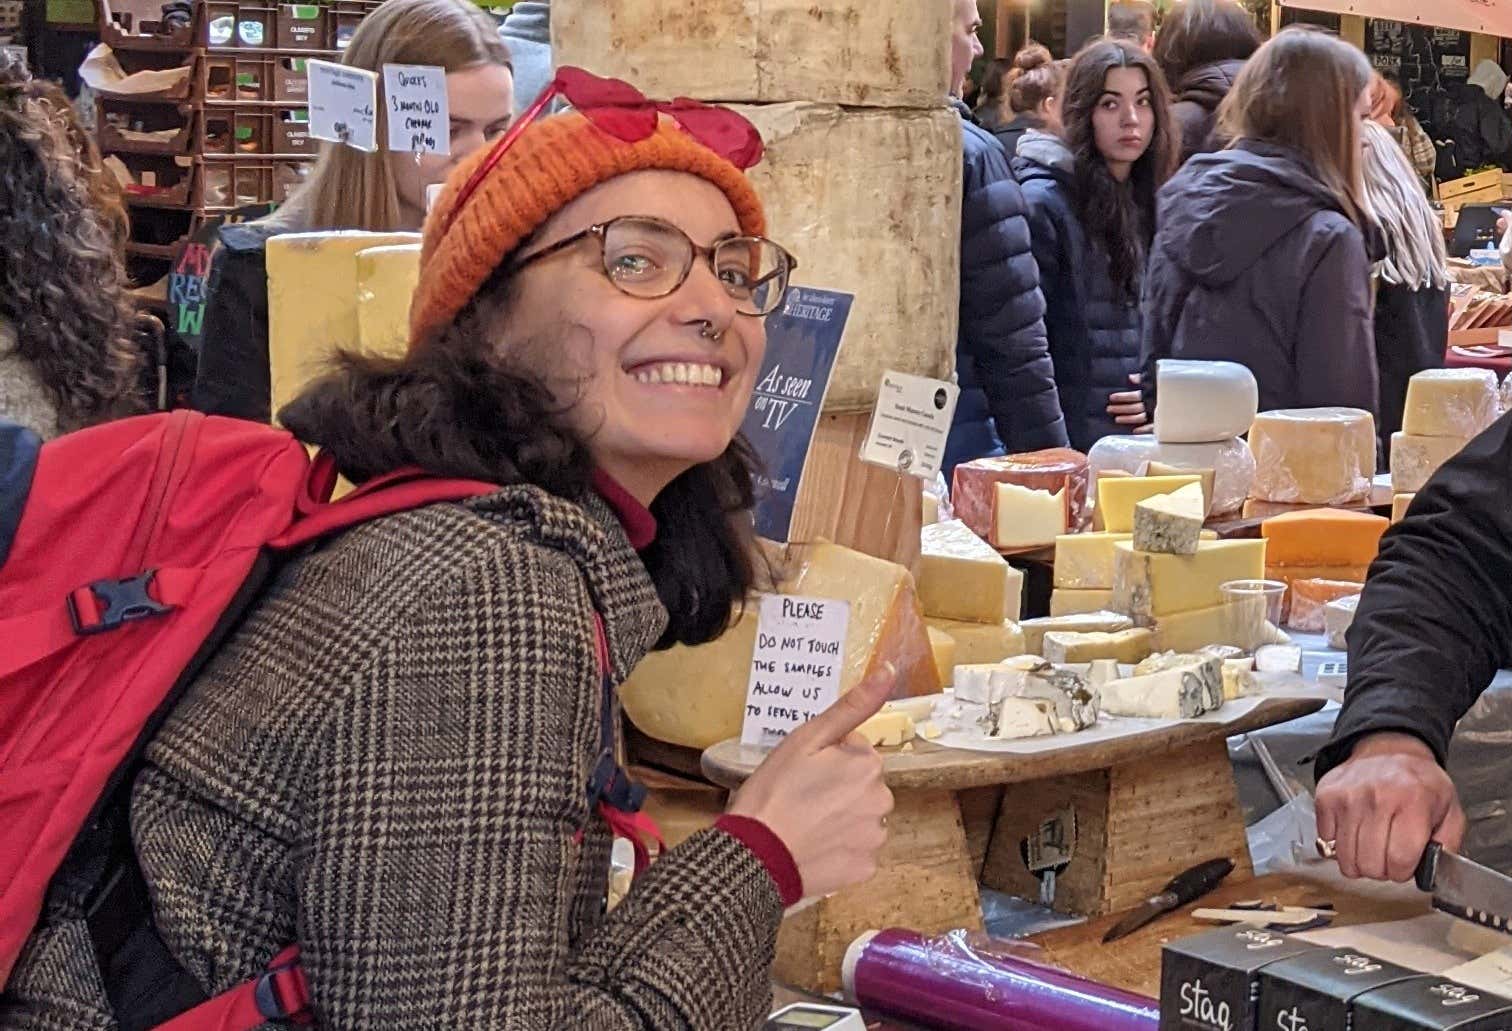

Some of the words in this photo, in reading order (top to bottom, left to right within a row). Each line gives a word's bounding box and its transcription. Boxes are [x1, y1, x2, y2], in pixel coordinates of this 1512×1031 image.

[391, 95, 399, 112] 3
[424, 99, 439, 114] OLD
[791, 305, 834, 322] HERITAGE
[756, 363, 783, 394] As
[785, 376, 812, 399] seen
[754, 397, 768, 411] on
[762, 399, 799, 431] TV
[783, 598, 824, 620] PLEASE
[759, 633, 776, 649] DO
[781, 637, 805, 651] NOT
[808, 639, 839, 655] TOUCH
[753, 660, 776, 672] THE
[784, 661, 832, 677] SAMPLES
[752, 681, 793, 697] ALLOW
[803, 687, 822, 700] US
[747, 705, 760, 716] TO
[768, 705, 799, 721] SERVE
[803, 712, 819, 722] YO
[1235, 930, 1283, 949] stag
[1333, 954, 1382, 975] stag
[1180, 979, 1232, 1031] stag
[1430, 984, 1479, 1005] stag
